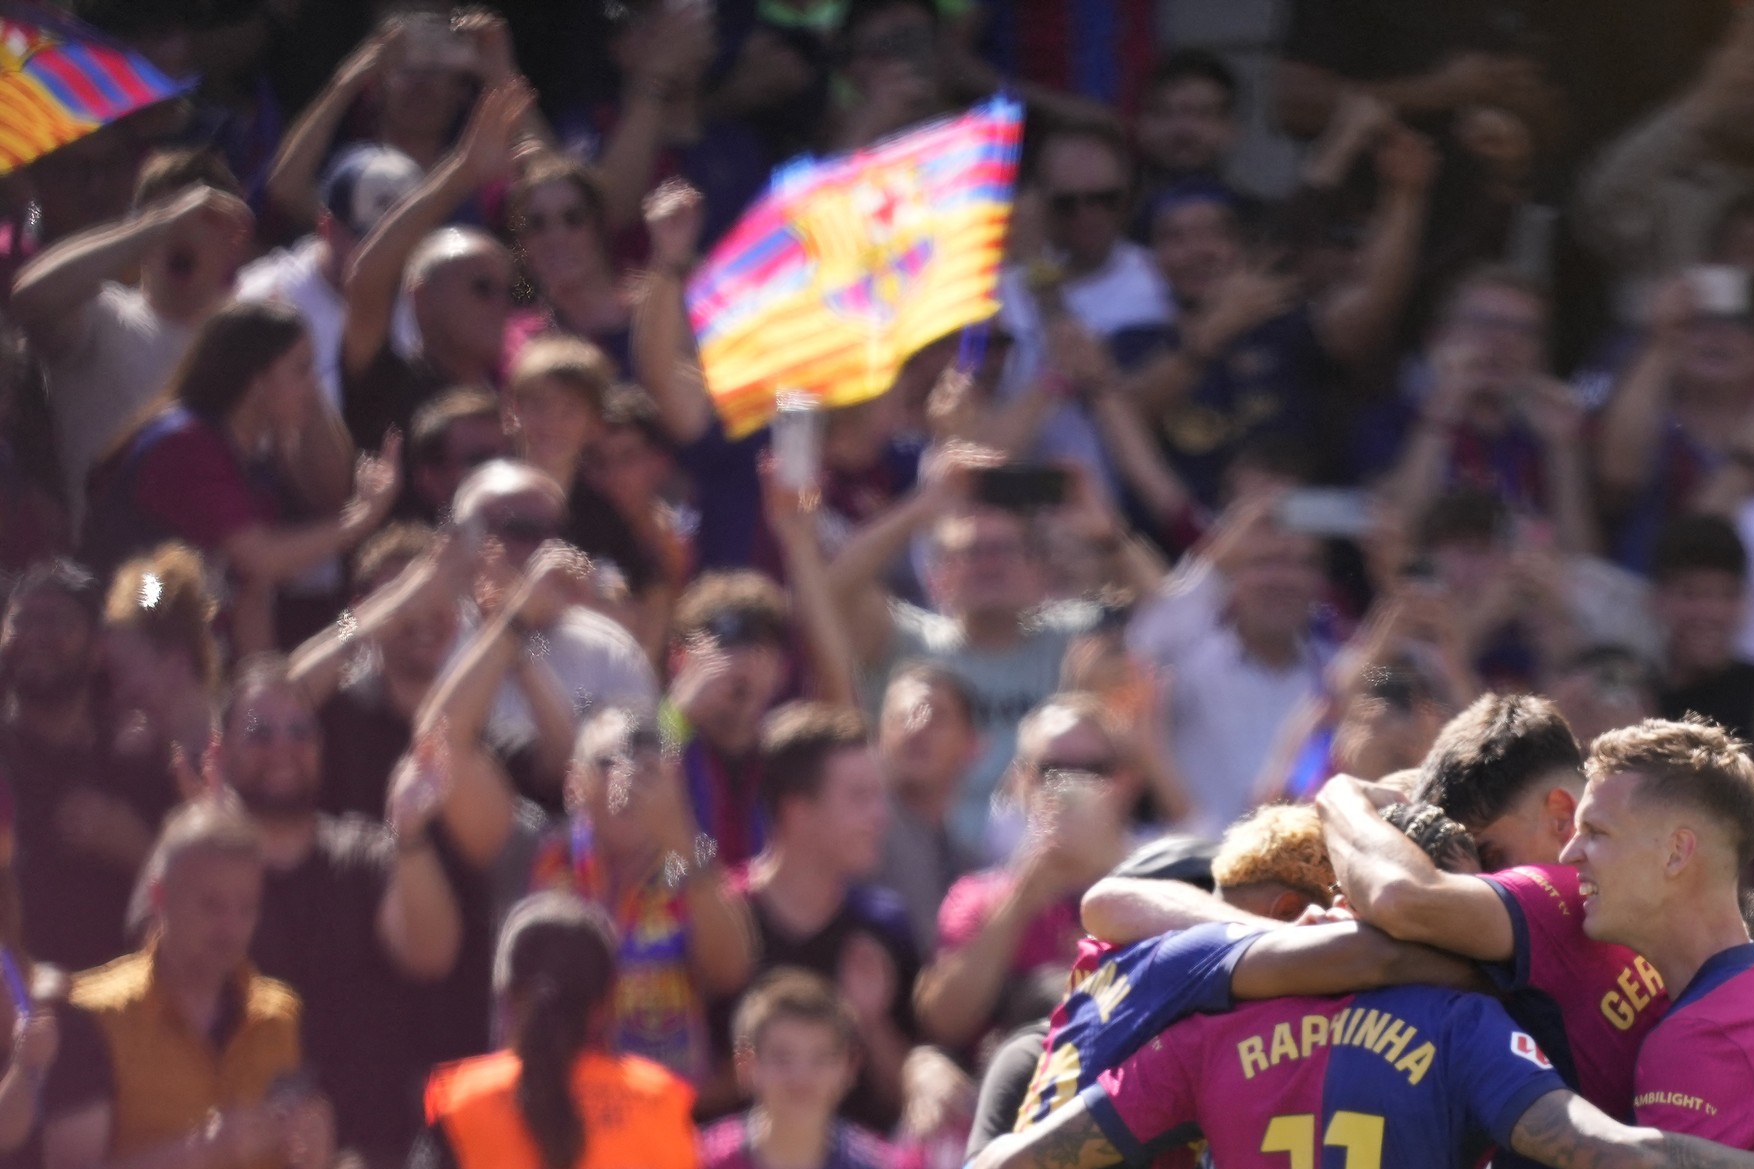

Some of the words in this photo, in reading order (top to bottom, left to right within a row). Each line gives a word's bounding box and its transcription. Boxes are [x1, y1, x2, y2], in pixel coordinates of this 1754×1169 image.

[1237, 1007, 1436, 1086] RAPHINHA
[1634, 1091, 1703, 1111] AMBILIGHT
[1705, 1102, 1718, 1116] tv
